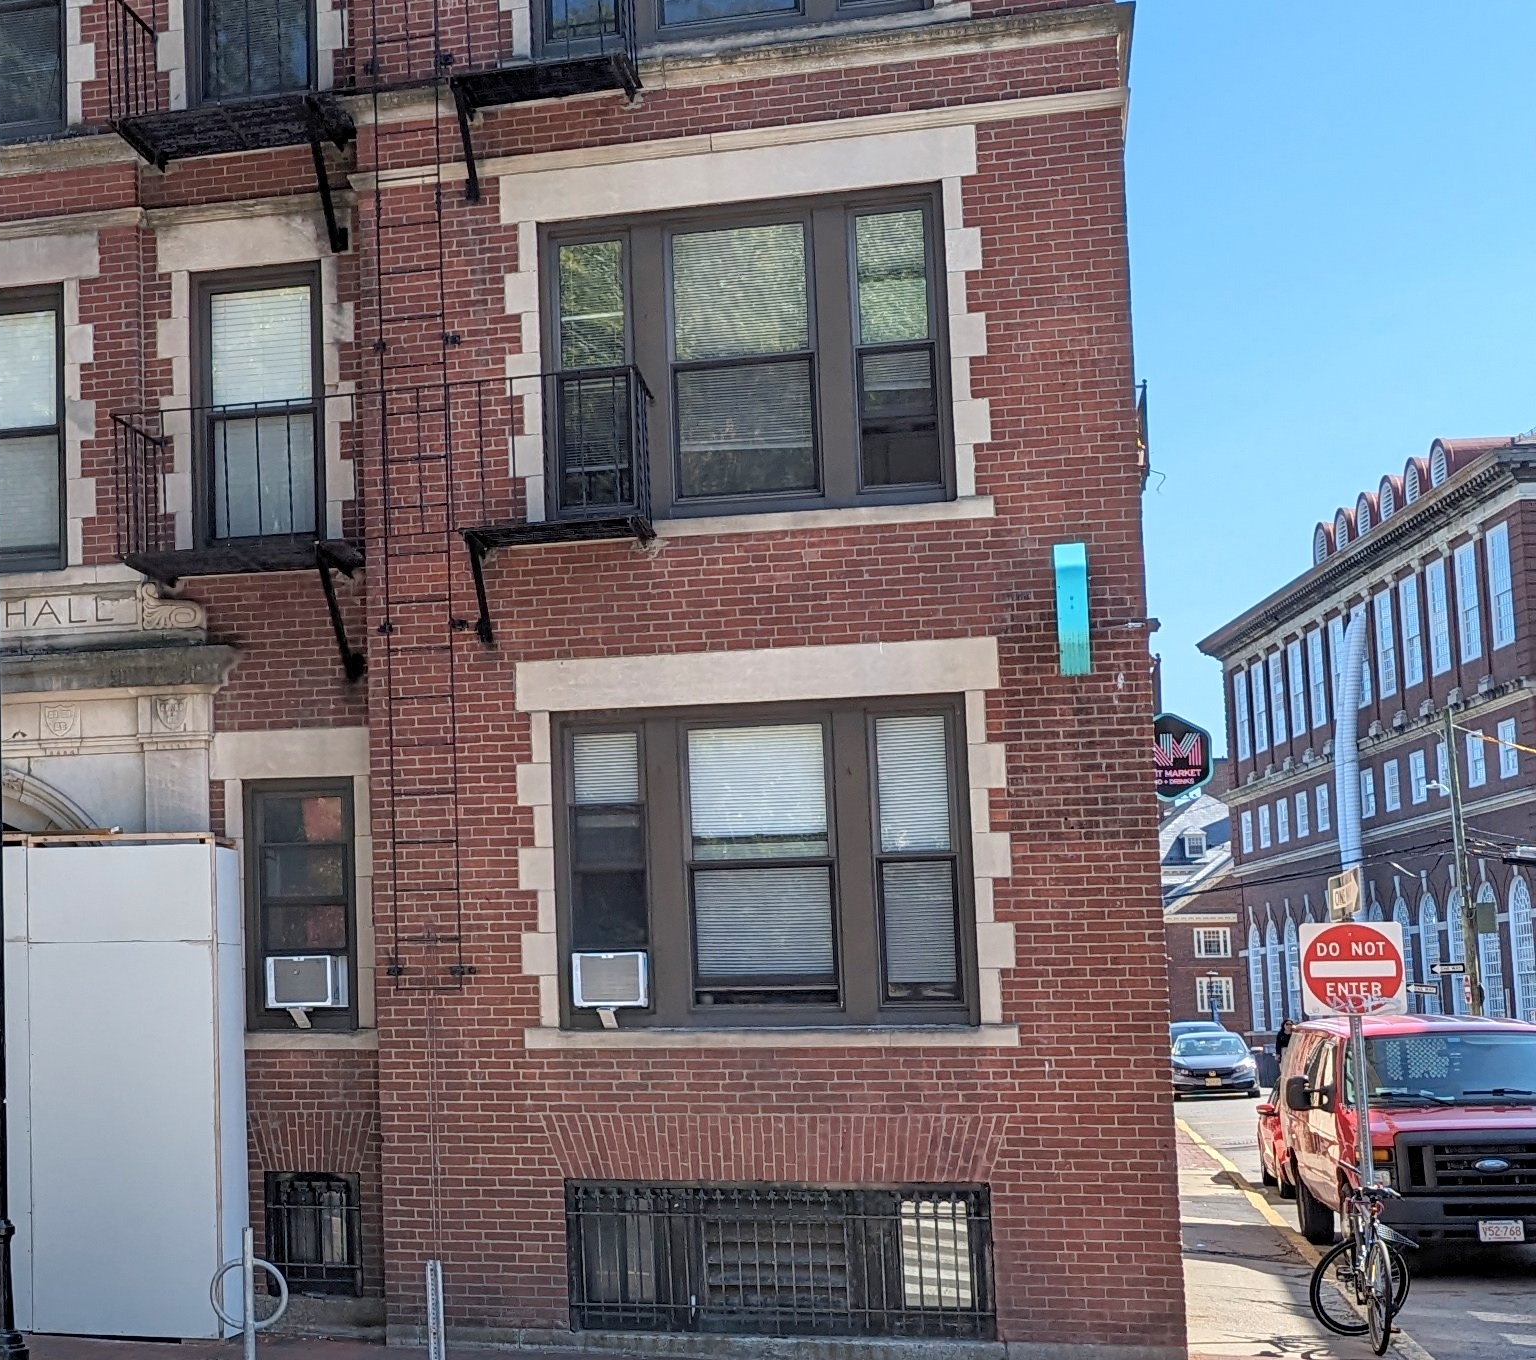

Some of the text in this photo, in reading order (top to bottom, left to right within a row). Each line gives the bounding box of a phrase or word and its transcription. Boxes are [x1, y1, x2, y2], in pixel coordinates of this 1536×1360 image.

[5, 595, 115, 628] HALL
[1165, 769, 1202, 777] MARKET
[1316, 941, 1385, 956] DO NOT
[1326, 982, 1383, 996] ENTER
